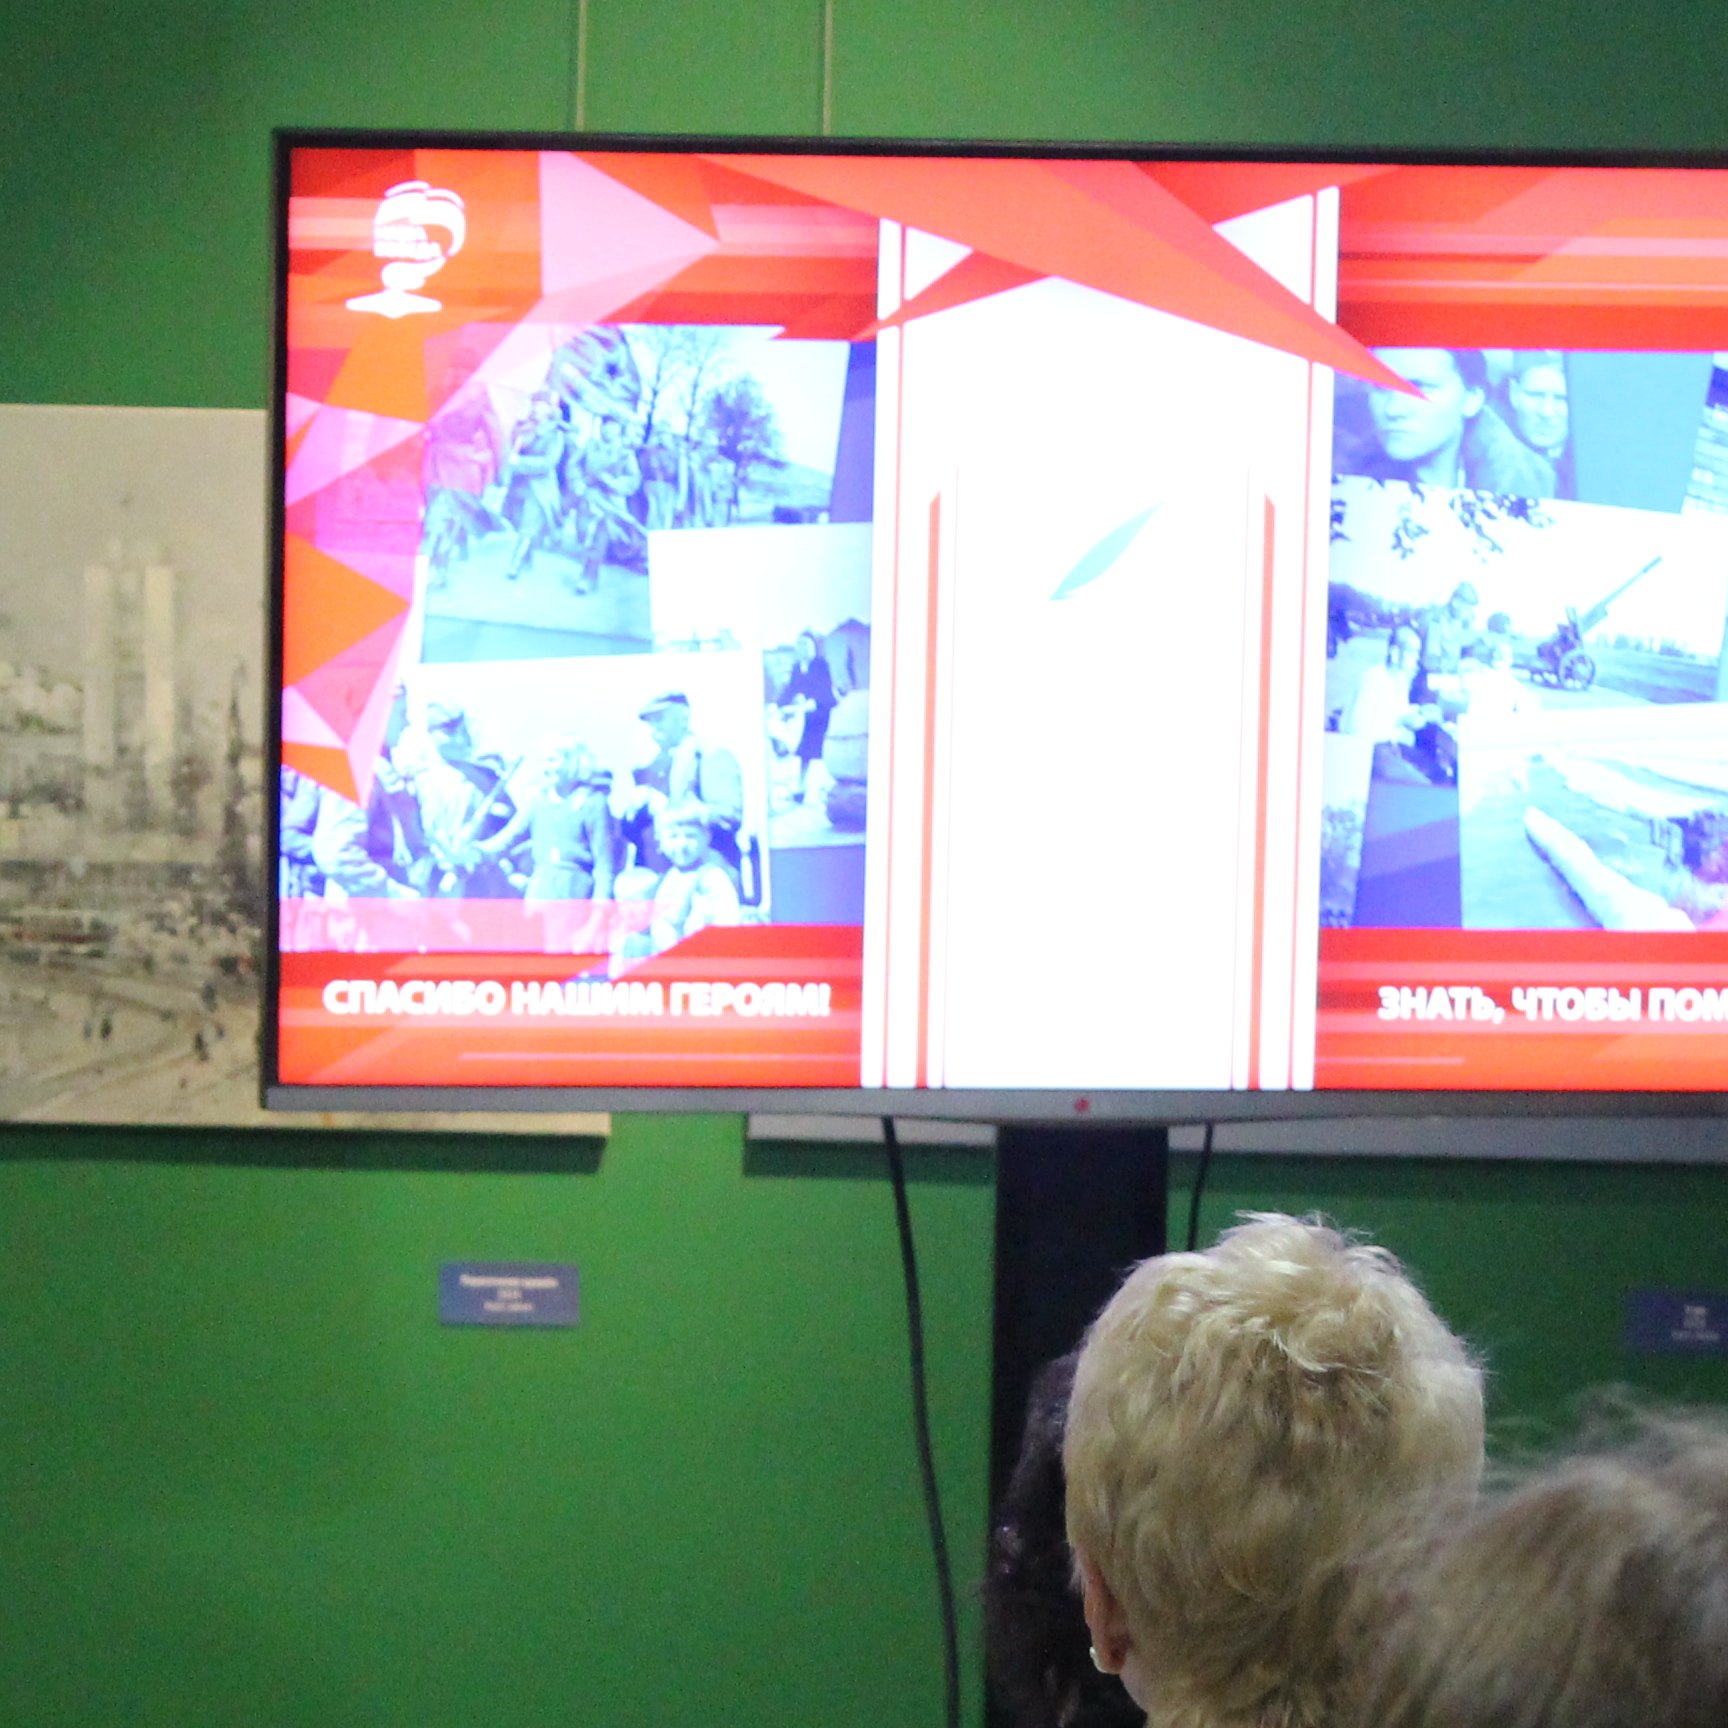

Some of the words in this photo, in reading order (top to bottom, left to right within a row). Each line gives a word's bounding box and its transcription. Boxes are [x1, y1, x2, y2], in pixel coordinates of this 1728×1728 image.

[322, 978, 507, 1016] СПАСИБО
[510, 980, 664, 1017] НАШИМ
[669, 981, 832, 1018] ГЕРОЯМ!
[1376, 986, 1505, 1024] ЗНАТЬ,
[1511, 987, 1642, 1022] ЧТОБЫ
